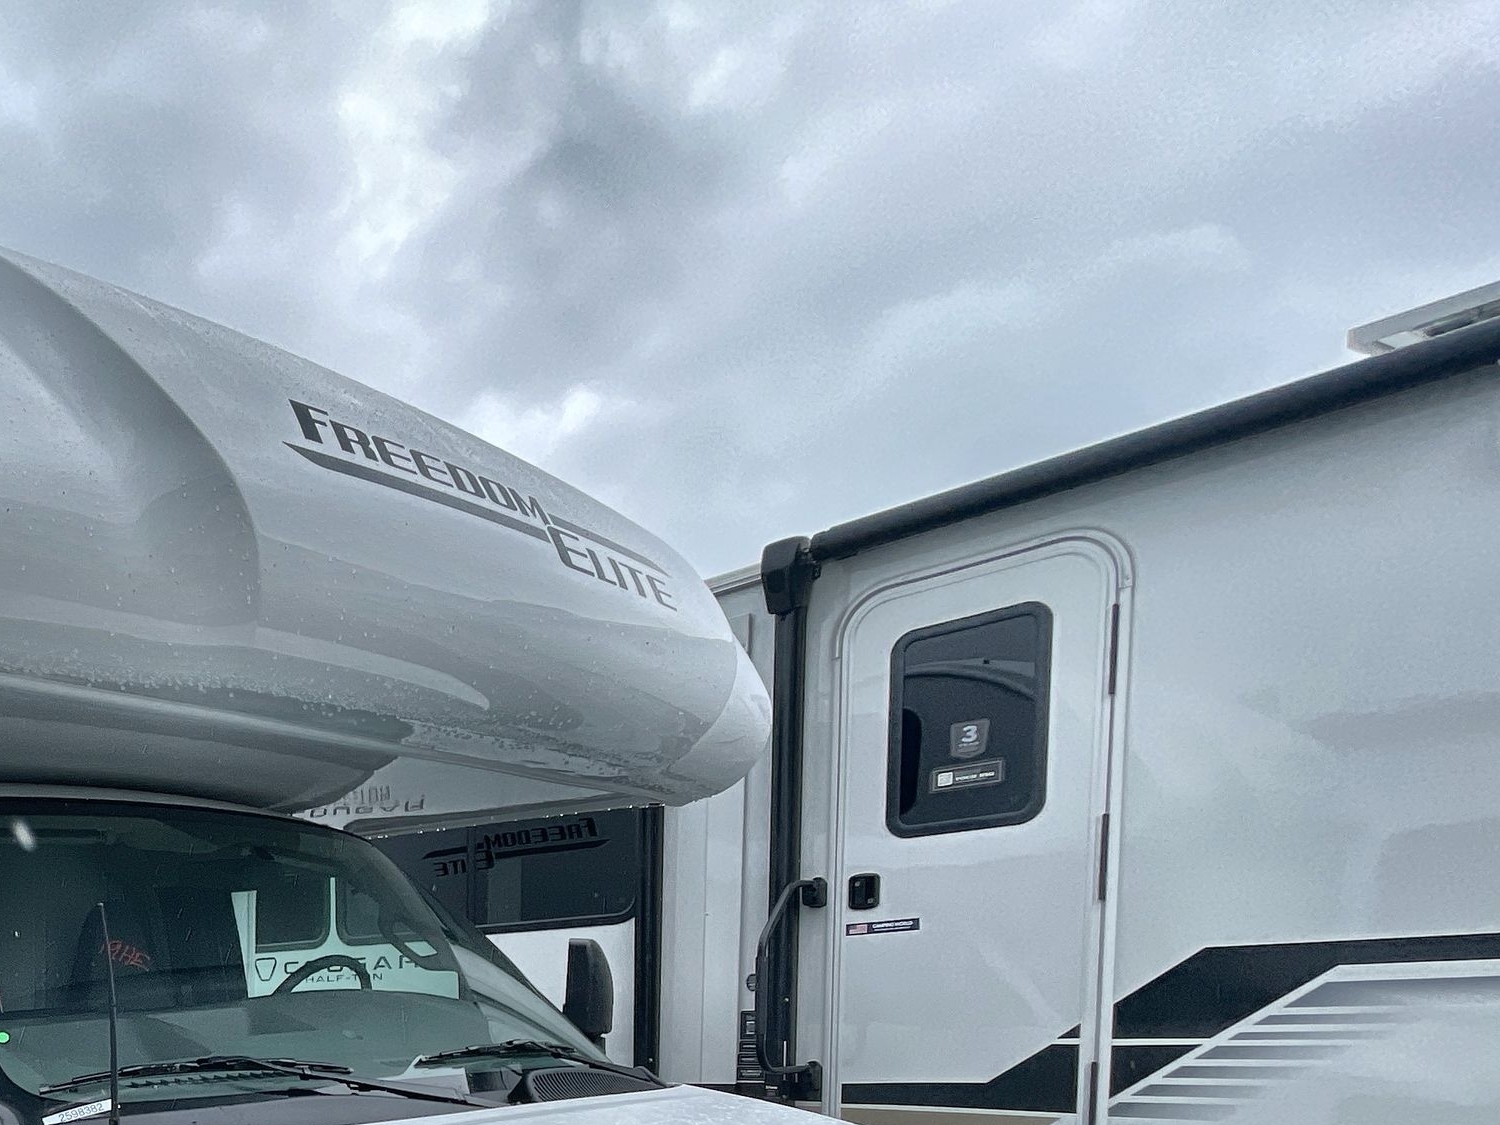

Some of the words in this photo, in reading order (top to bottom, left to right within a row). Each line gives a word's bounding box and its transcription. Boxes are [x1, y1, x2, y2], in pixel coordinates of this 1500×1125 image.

[288, 398, 551, 526] FREEDOM
[547, 525, 678, 613] ELITE
[961, 725, 978, 742] 3
[304, 972, 383, 984] HALF-TN
[58, 1102, 105, 1122] 2598382
